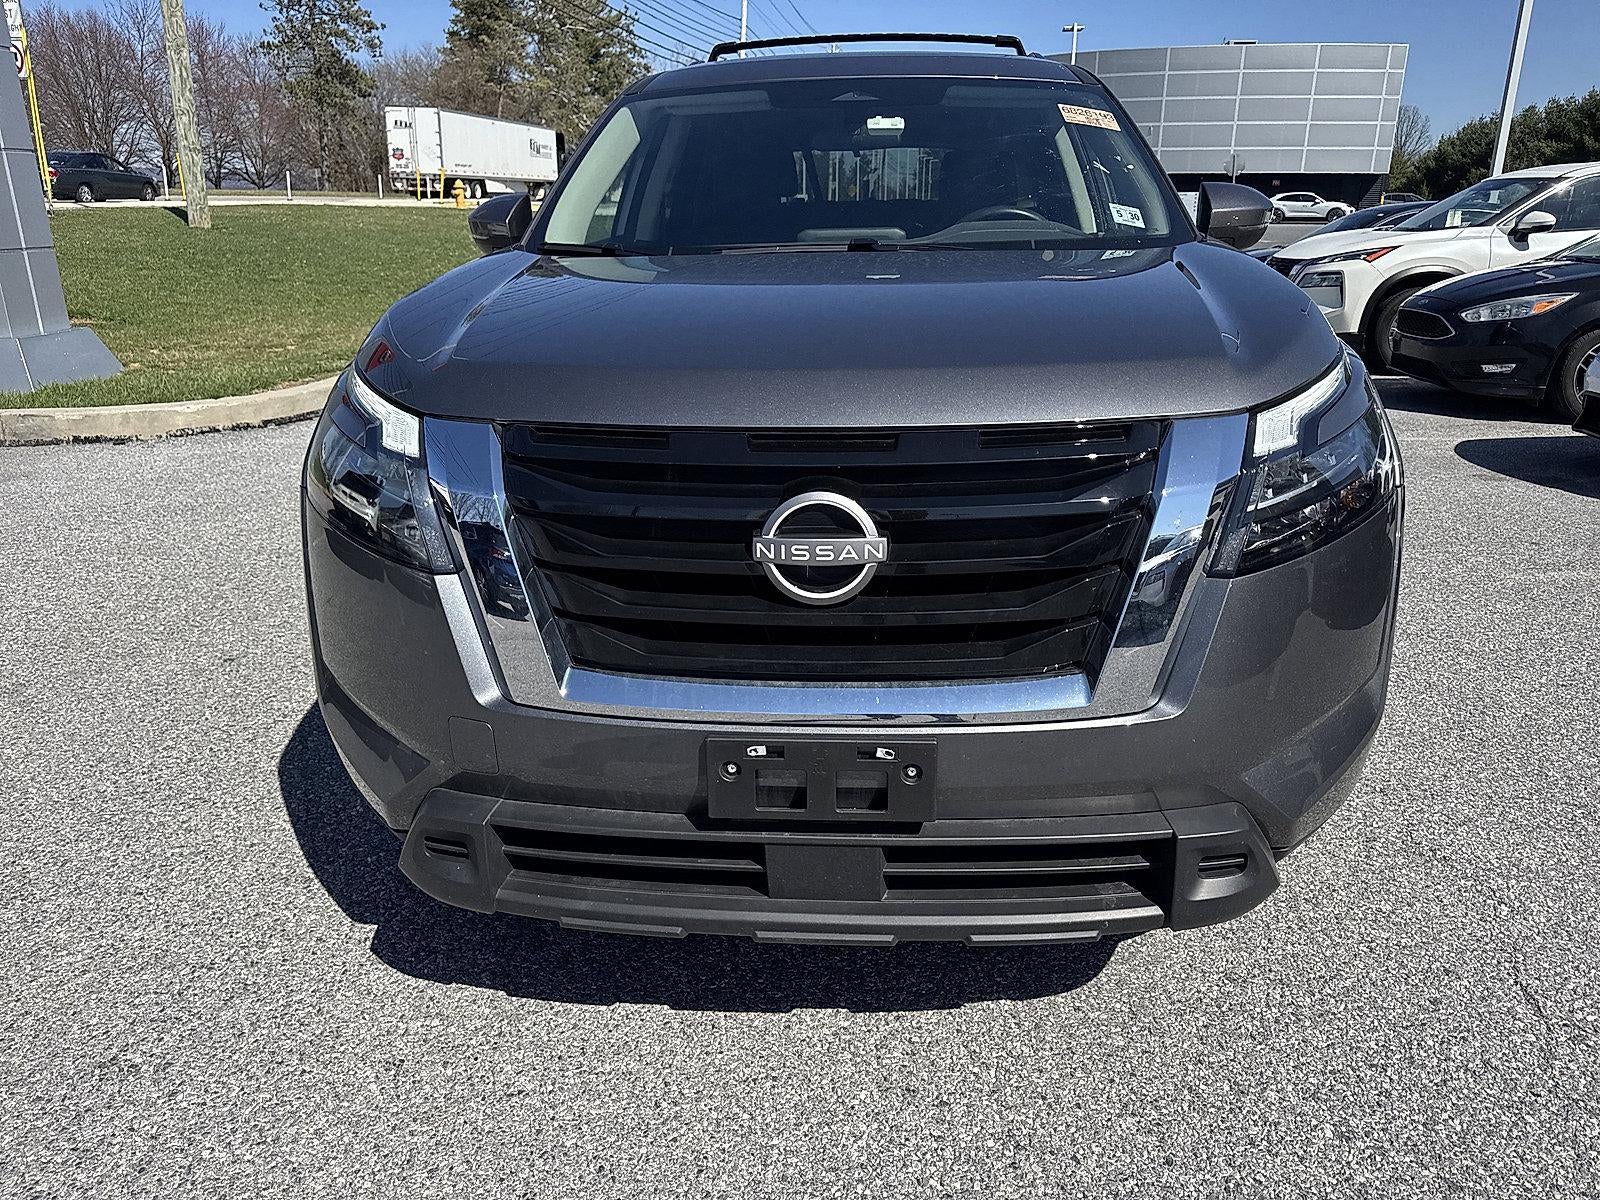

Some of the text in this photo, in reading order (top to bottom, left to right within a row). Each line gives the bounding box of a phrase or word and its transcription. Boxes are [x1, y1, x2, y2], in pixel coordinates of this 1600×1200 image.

[1115, 209, 1123, 217] 5
[1128, 212, 1140, 221] 30
[756, 543, 883, 561] NISSAN
